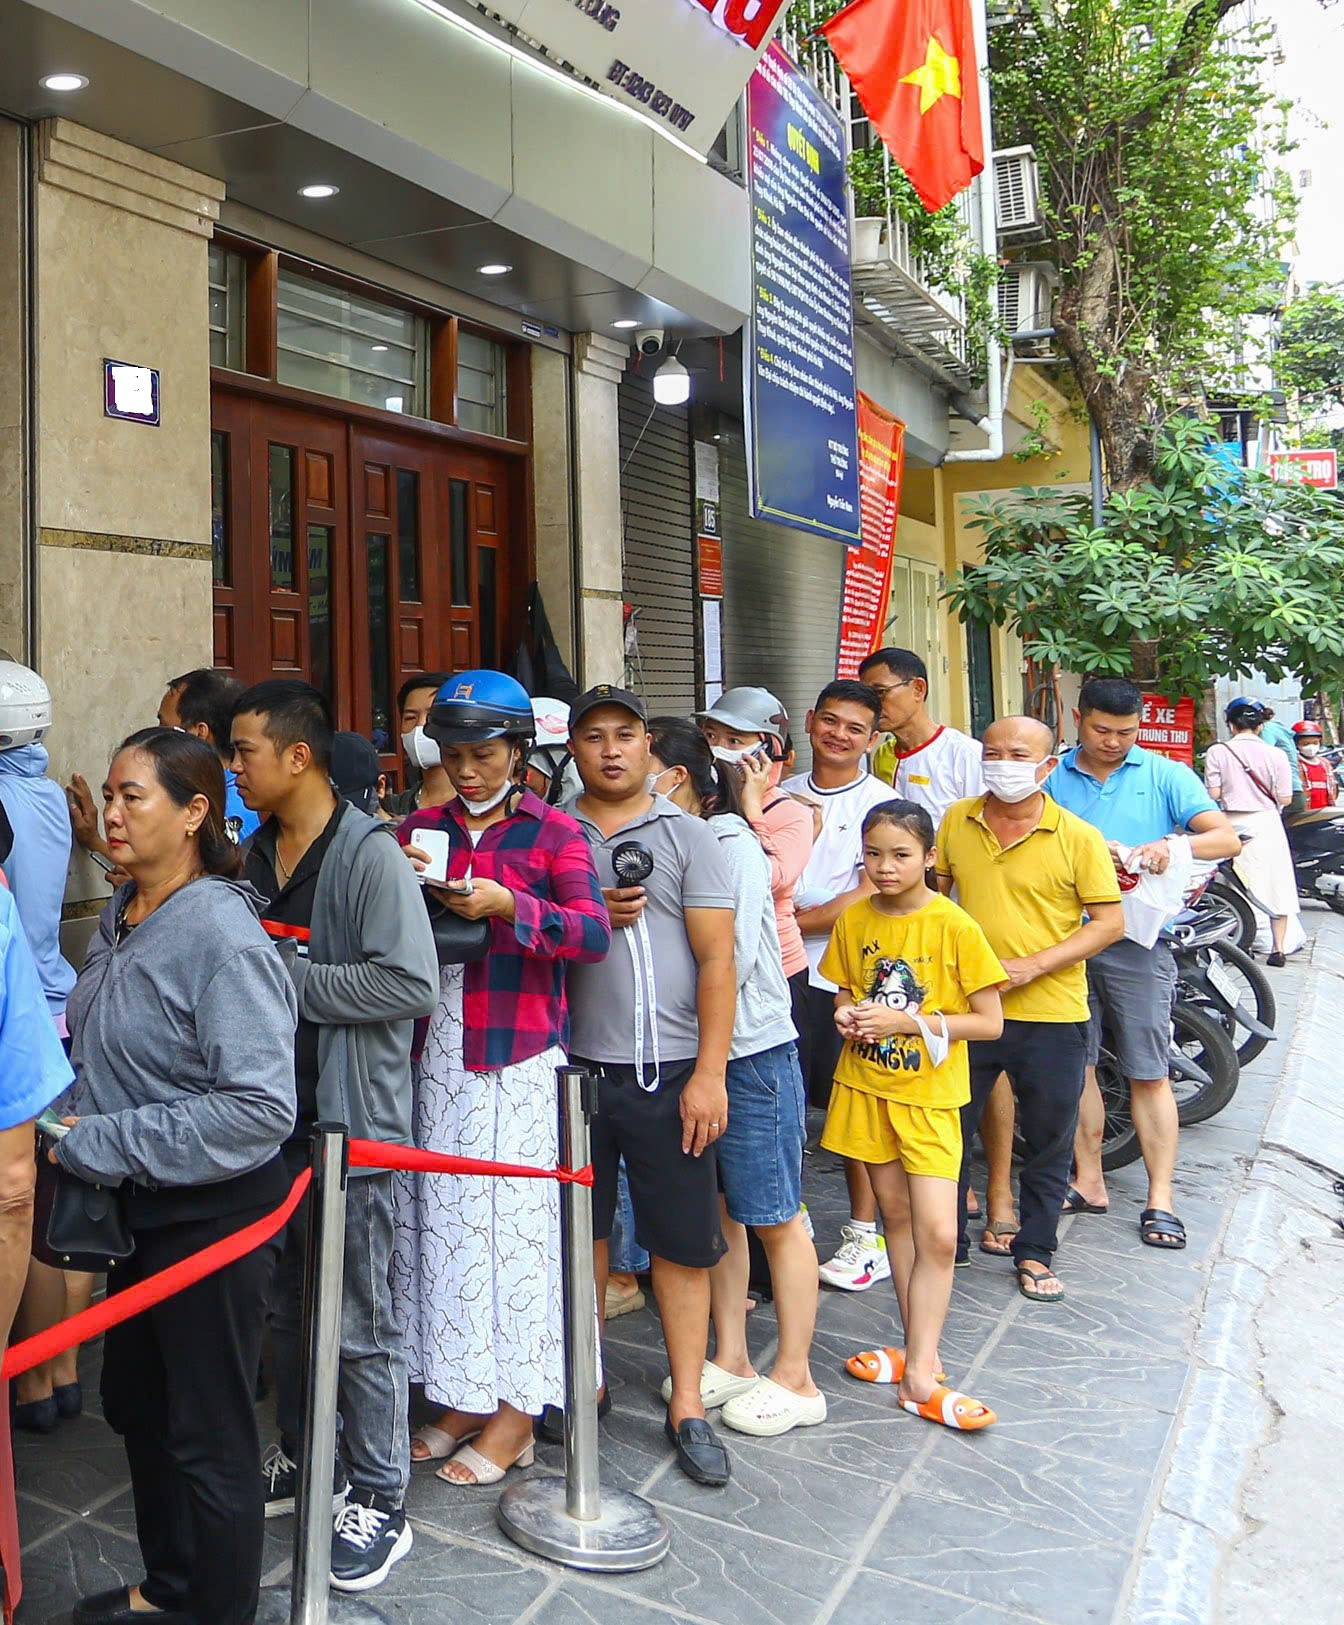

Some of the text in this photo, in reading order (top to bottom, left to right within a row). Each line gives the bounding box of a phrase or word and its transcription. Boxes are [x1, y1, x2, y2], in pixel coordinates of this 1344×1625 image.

[1156, 708, 1176, 724] XE
[1138, 728, 1189, 744] TRUNG THU
